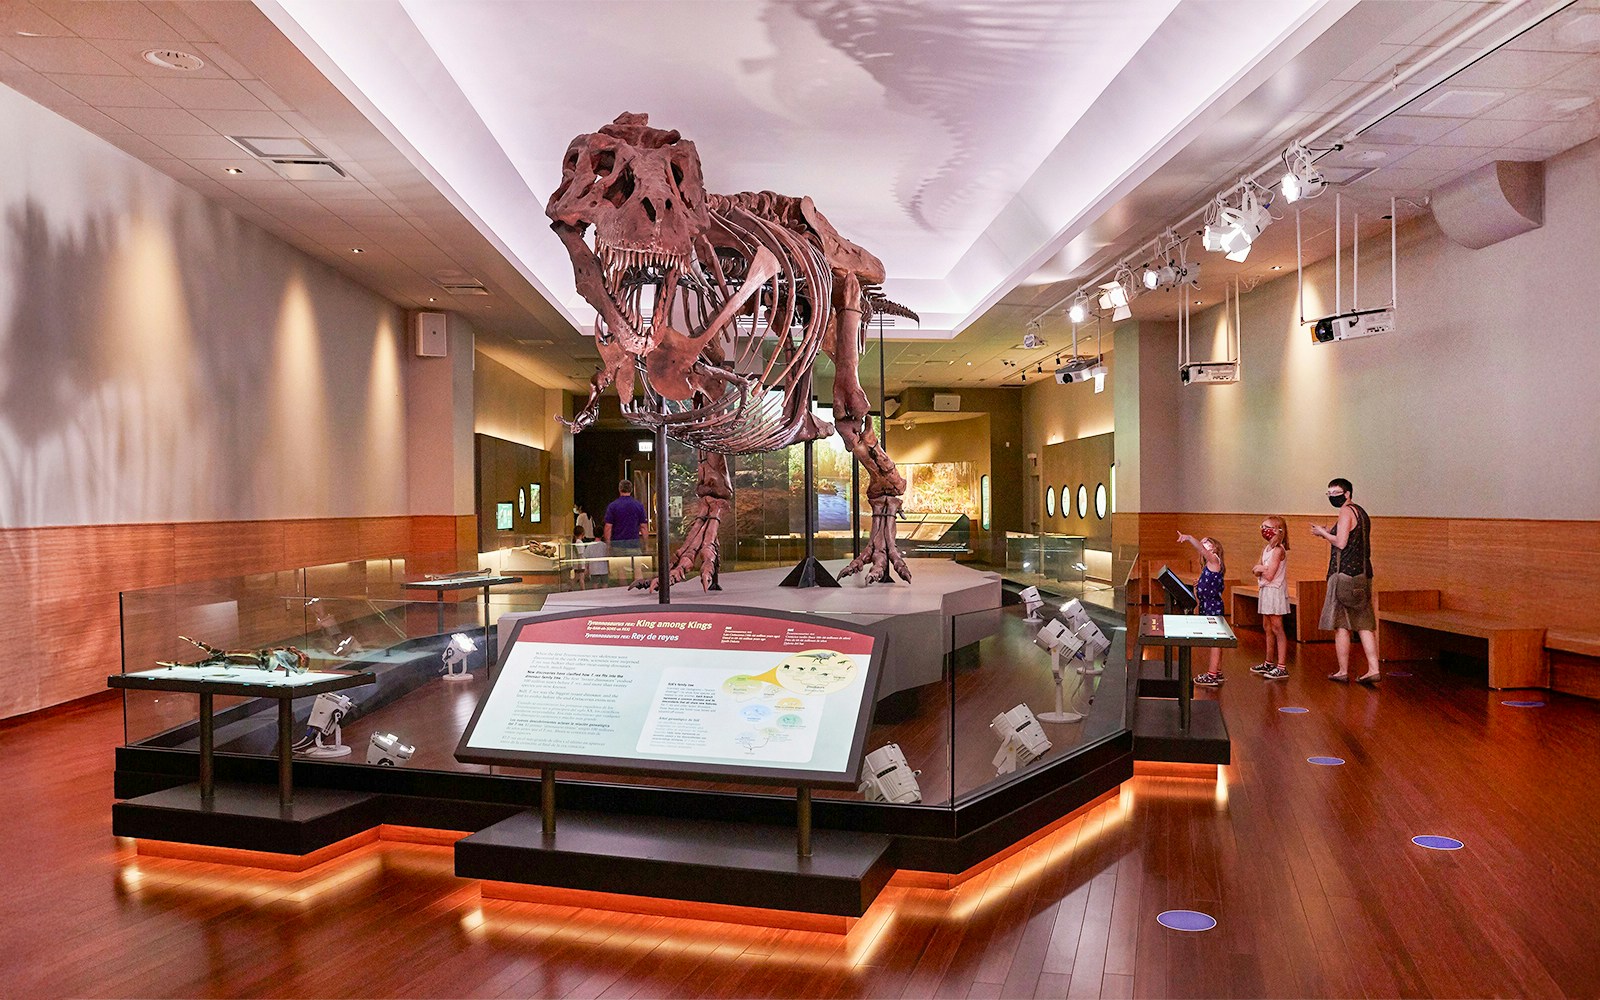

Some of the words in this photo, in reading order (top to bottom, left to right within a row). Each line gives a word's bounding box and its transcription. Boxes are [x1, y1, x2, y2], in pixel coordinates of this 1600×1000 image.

[636, 620, 656, 628] King
[688, 621, 712, 630] Kings
[631, 633, 646, 641] Rey
